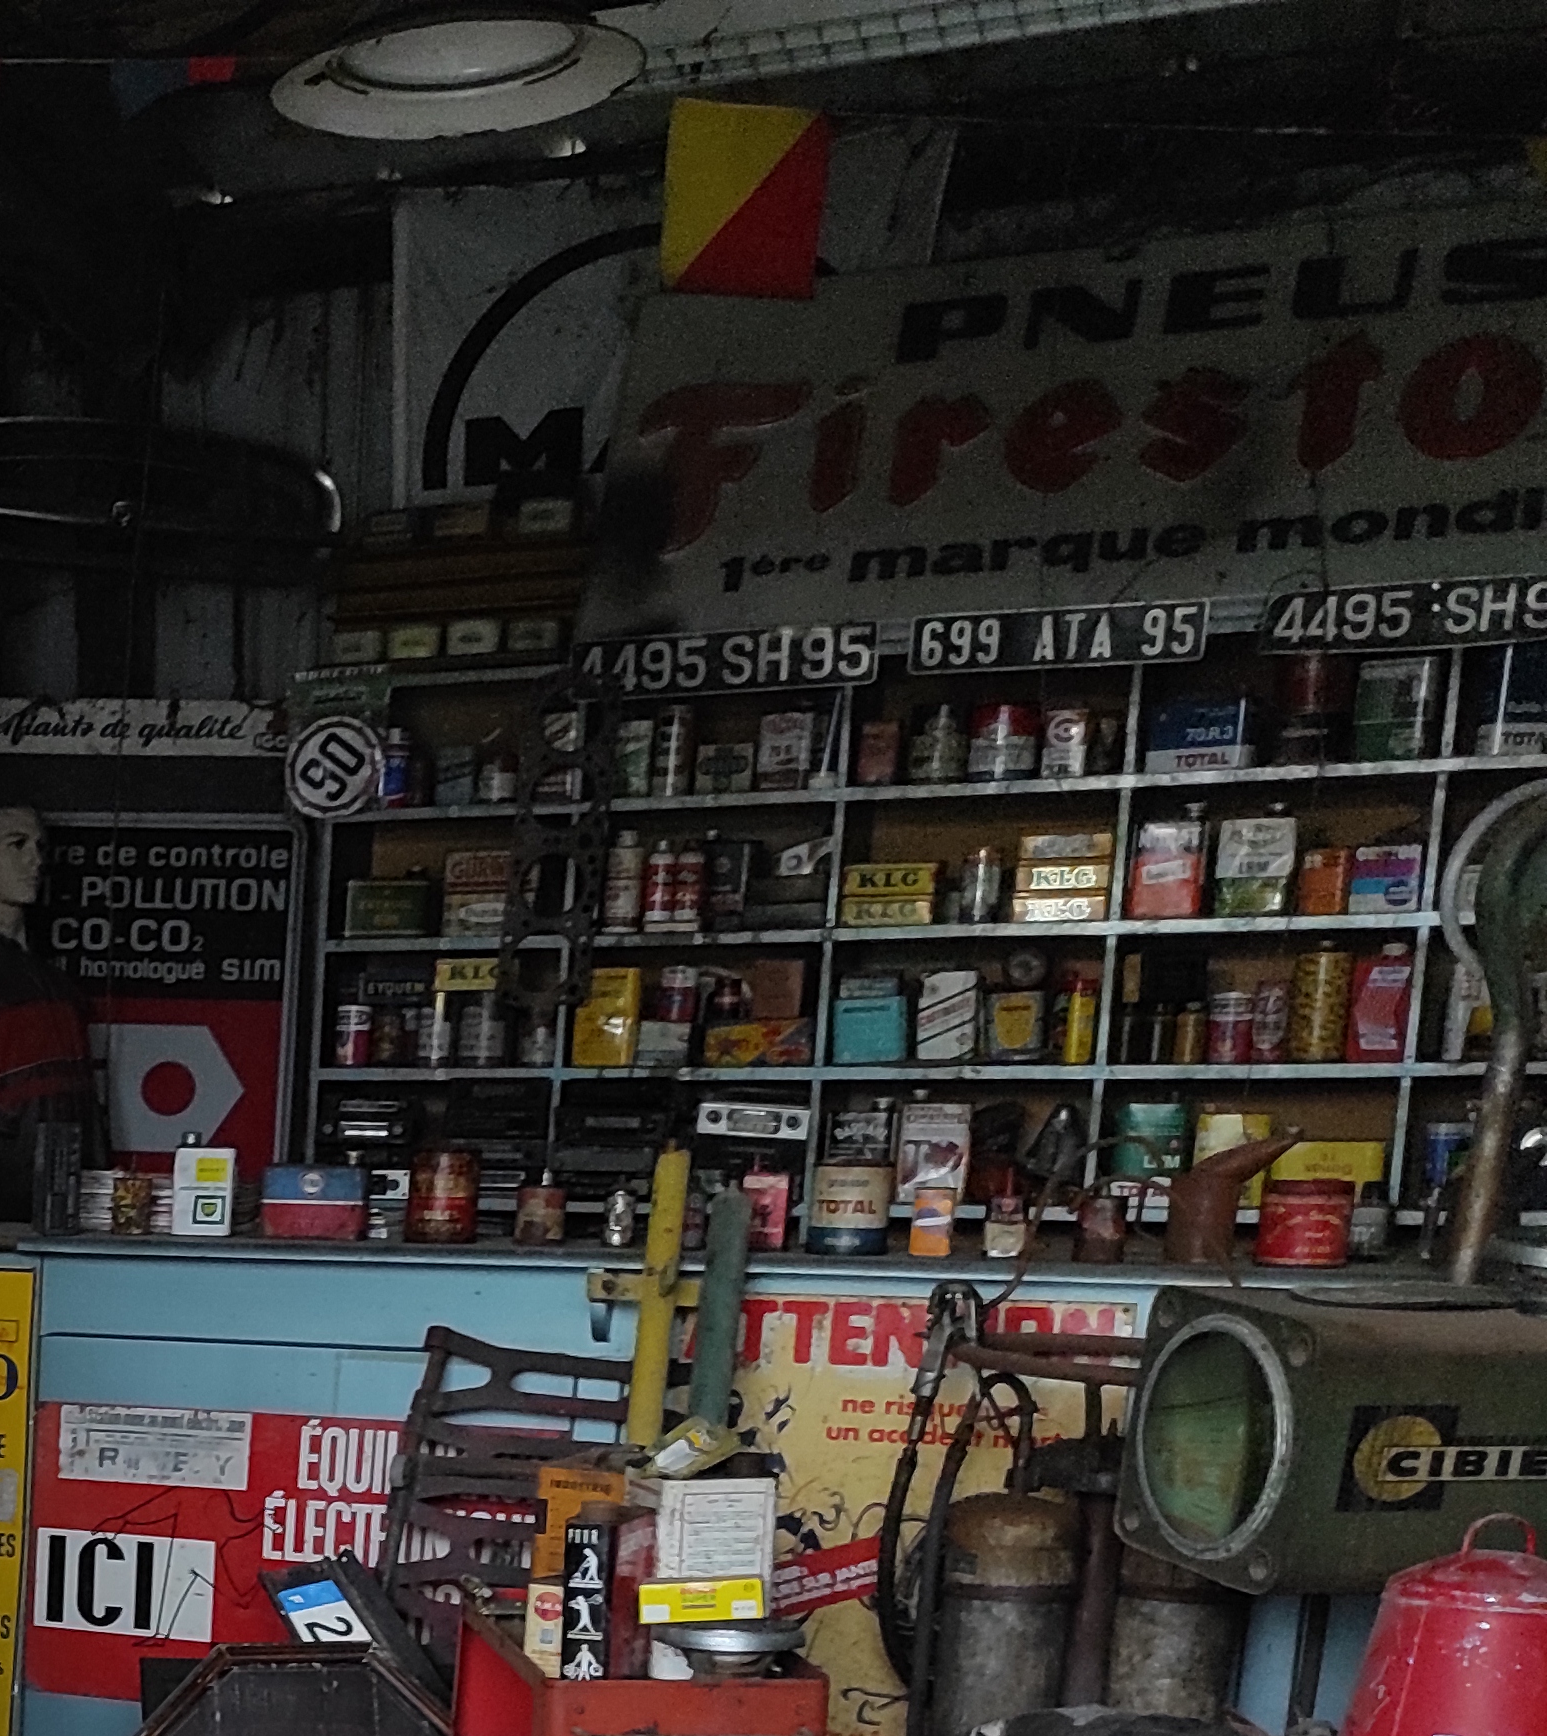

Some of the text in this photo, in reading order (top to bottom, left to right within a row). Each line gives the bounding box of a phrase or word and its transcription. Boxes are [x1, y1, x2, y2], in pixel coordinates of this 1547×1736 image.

[897, 236, 1547, 364] PNEUS
[849, 522, 1207, 582] marque
[919, 605, 1198, 666] 699 ATA 95
[1273, 591, 1414, 643] 4495
[722, 631, 789, 684] SH
[801, 626, 872, 680] 95
[100, 721, 131, 740] de
[97, 842, 137, 867] de
[81, 875, 287, 911] POLLUTION
[826, 1425, 859, 1442] un
[841, 1399, 879, 1416] ne
[47, 1535, 155, 1631] ICI
